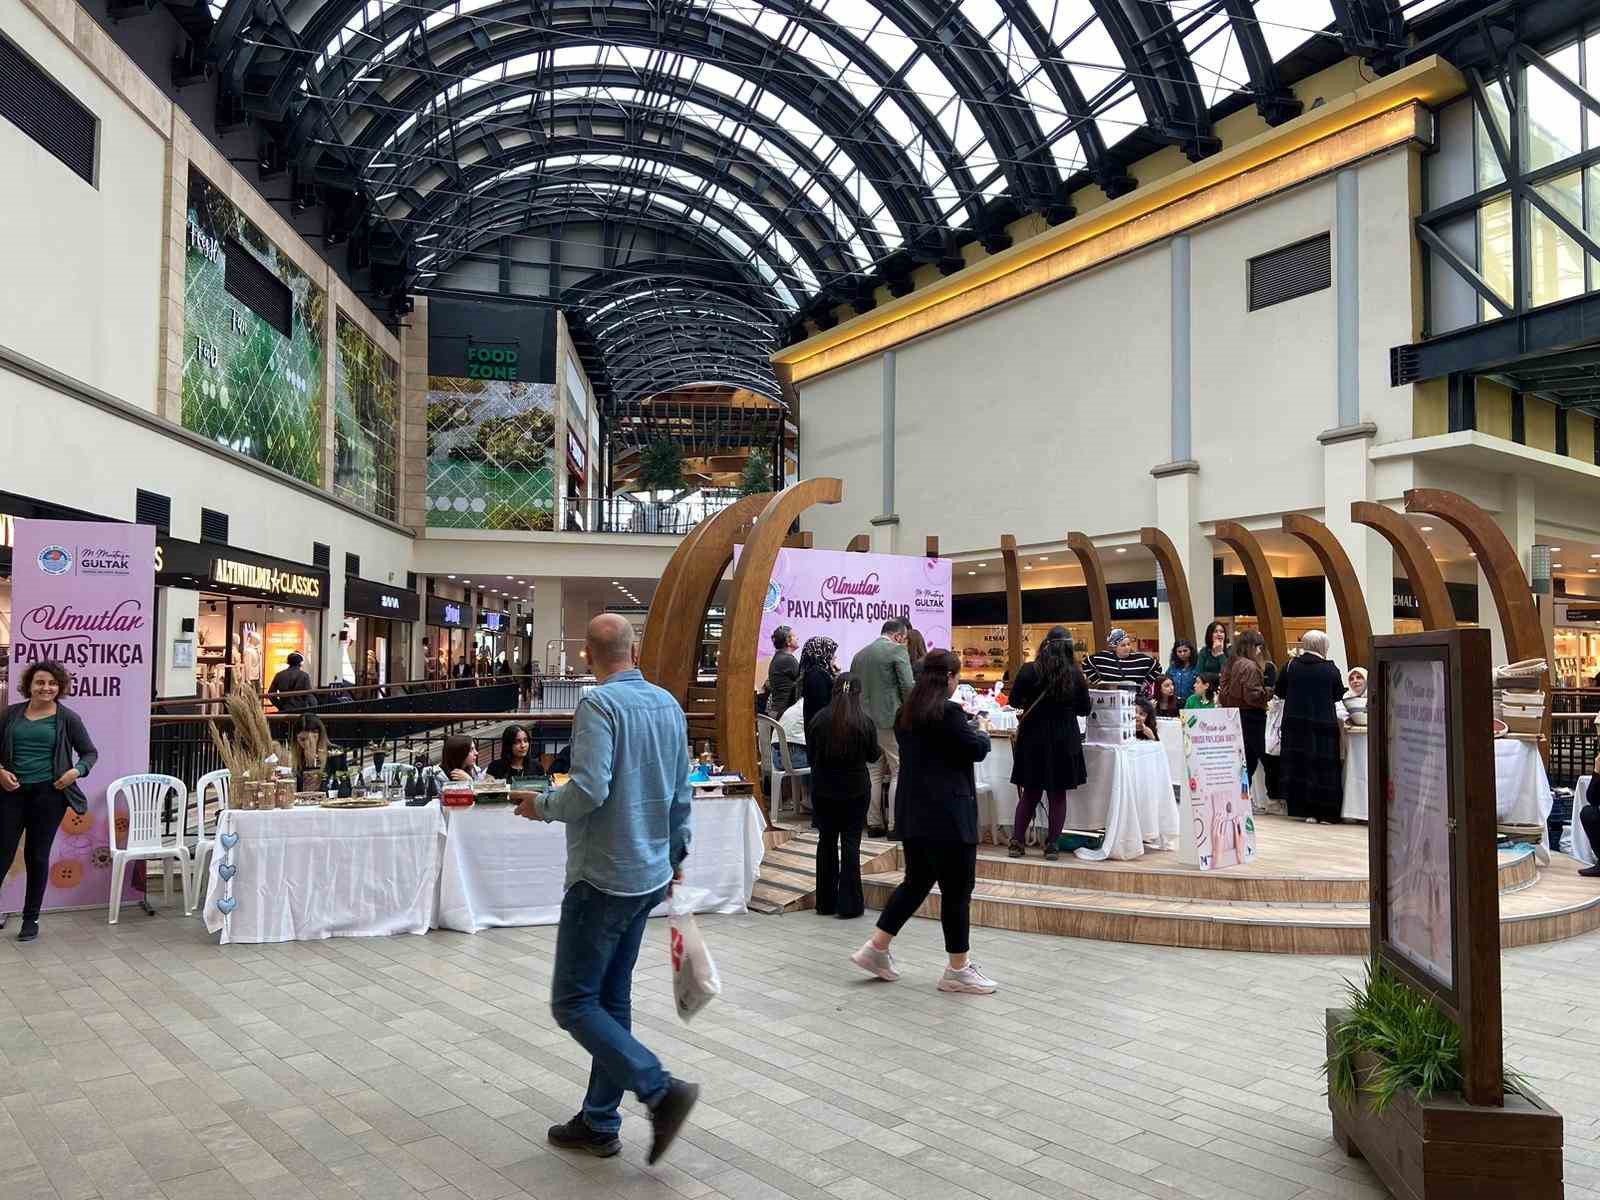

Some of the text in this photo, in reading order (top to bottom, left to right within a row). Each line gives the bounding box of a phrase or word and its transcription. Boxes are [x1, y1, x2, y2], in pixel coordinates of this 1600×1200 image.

[468, 348, 518, 363] FOOD
[469, 364, 518, 380] ZONE
[280, 572, 319, 597] CLASSICS
[821, 572, 880, 601] Umutlar
[787, 600, 865, 623] PAYLAŞTIKÇA
[1115, 597, 1151, 610] KEMAL
[1393, 594, 1413, 608] EMAL
[20, 600, 145, 643] Umutlar
[14, 642, 144, 668] PAYLAŞTIKÇA
[68, 672, 122, 697] ĞALIR
